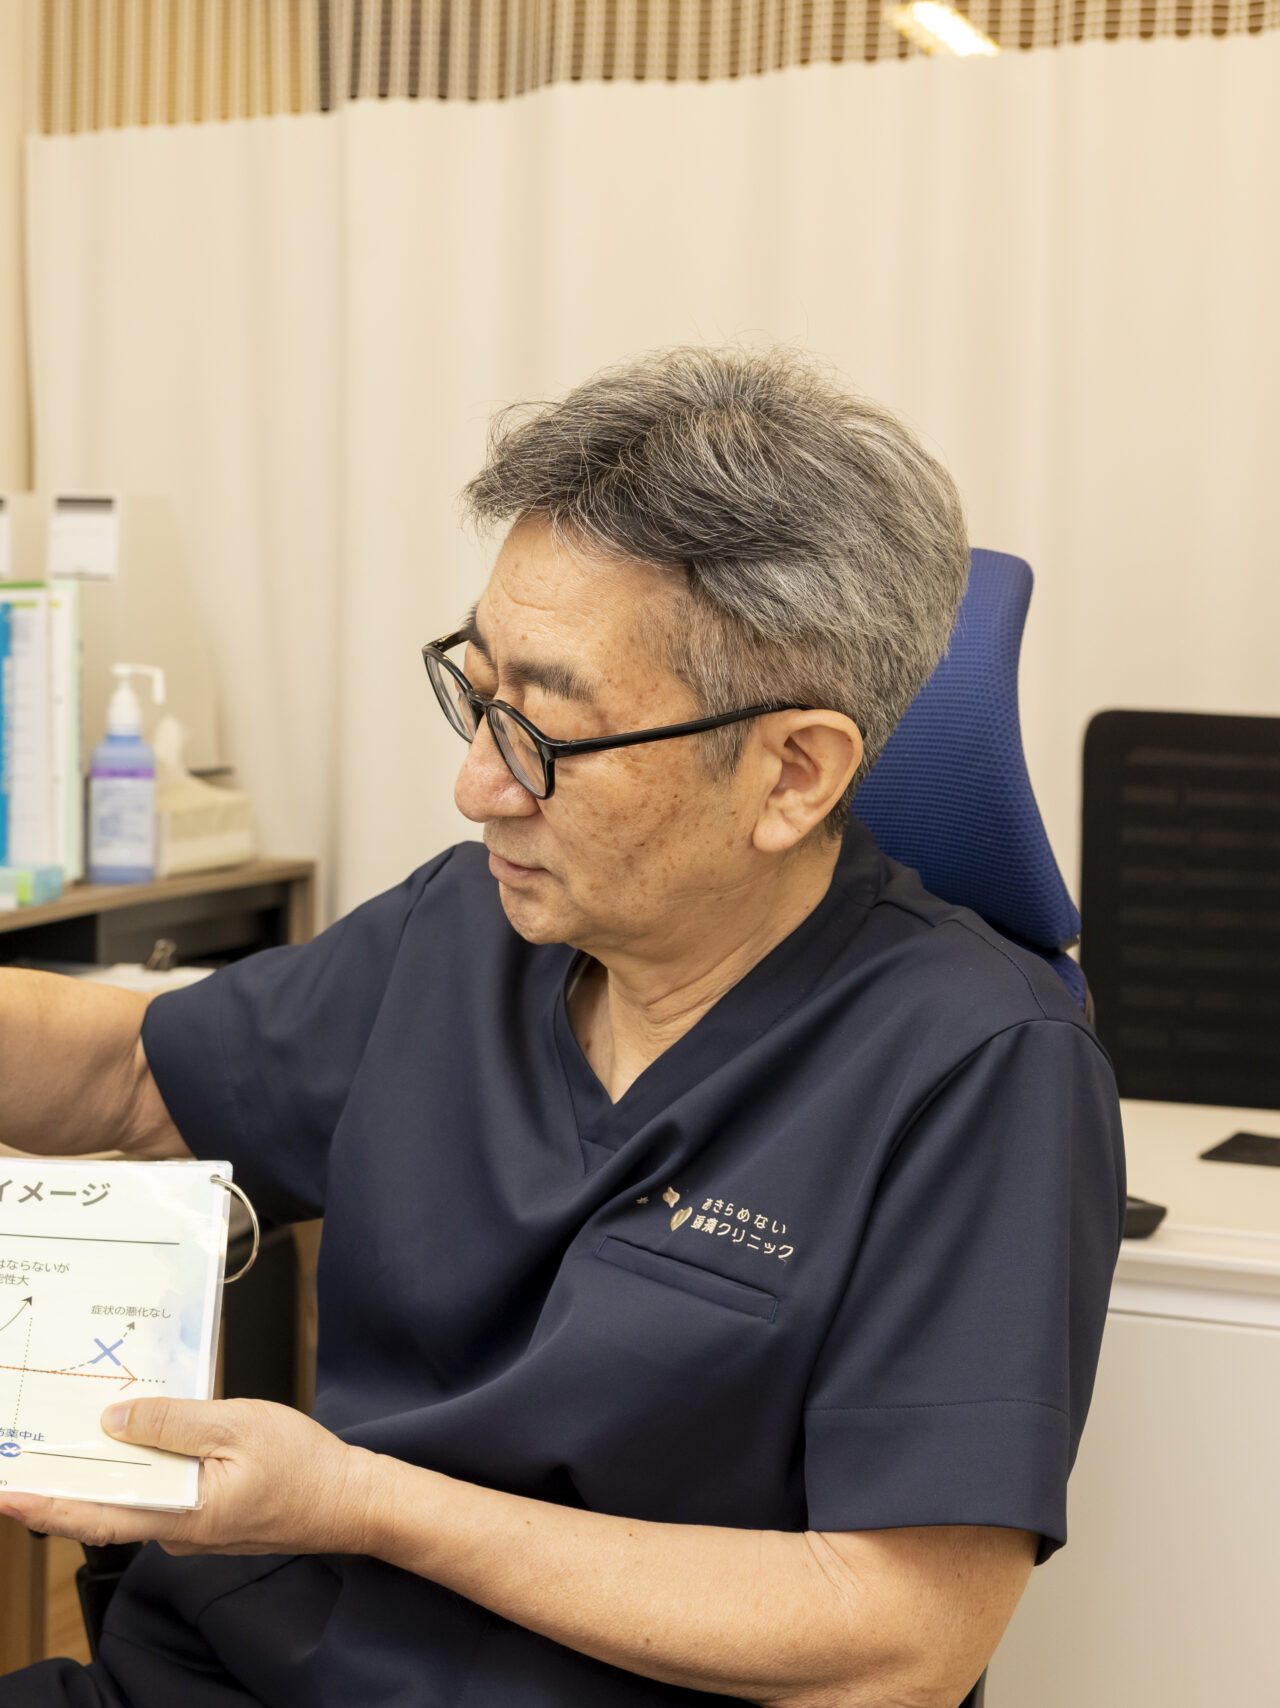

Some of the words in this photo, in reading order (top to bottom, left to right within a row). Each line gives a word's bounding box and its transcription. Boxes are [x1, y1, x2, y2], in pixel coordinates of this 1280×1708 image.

[91, 1304, 172, 1319] 症状の悪化なし
